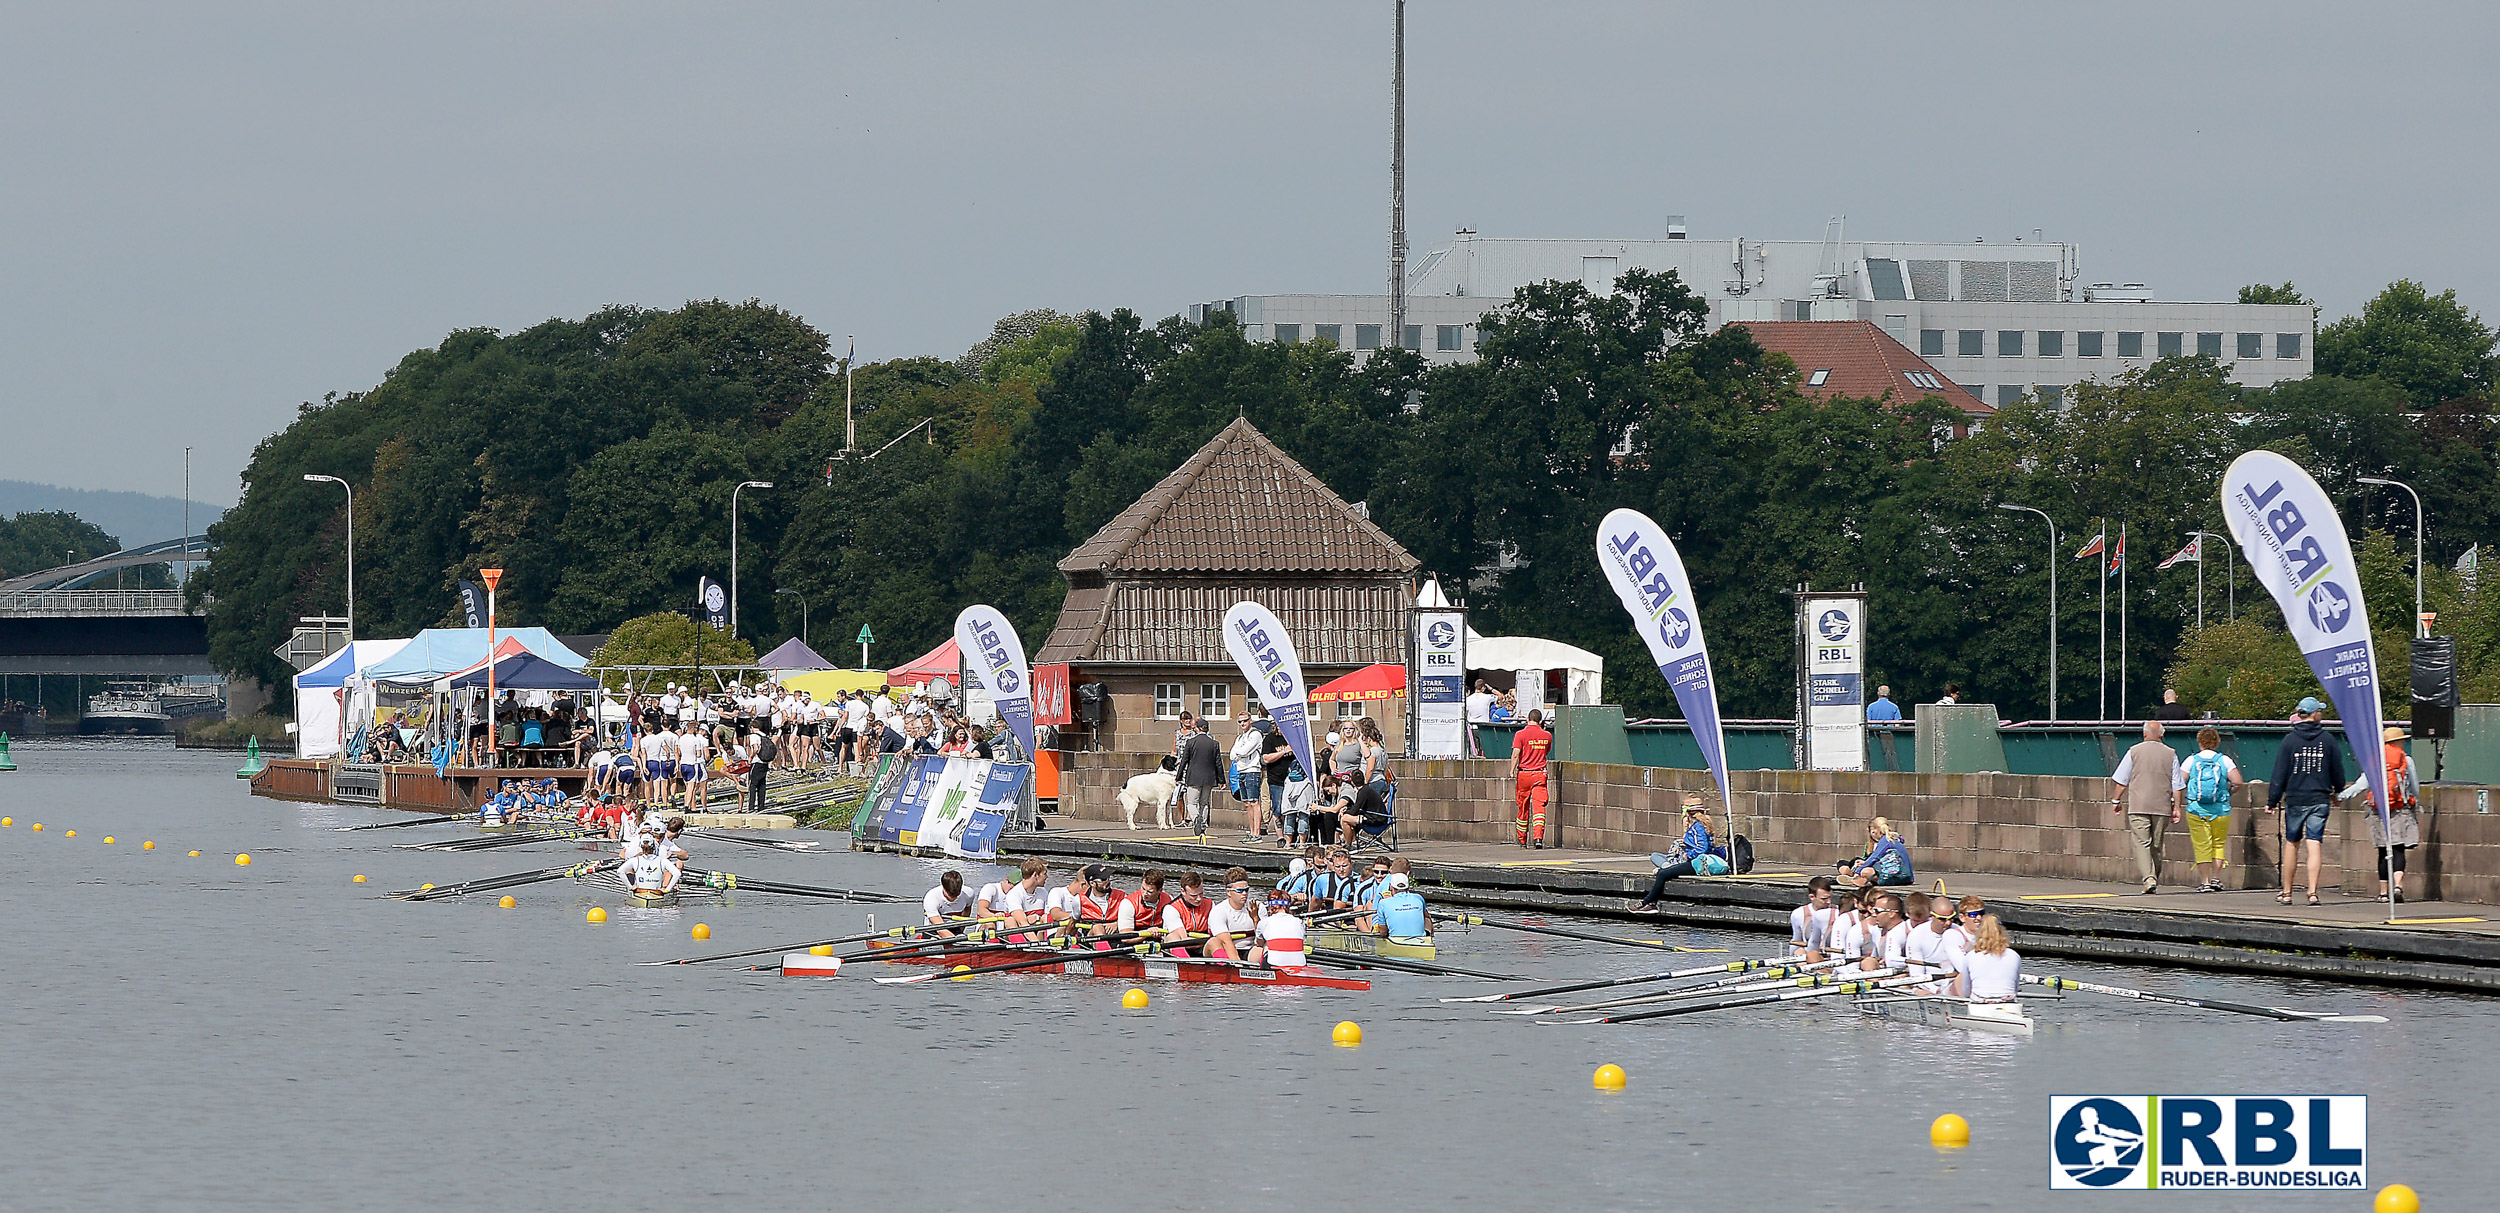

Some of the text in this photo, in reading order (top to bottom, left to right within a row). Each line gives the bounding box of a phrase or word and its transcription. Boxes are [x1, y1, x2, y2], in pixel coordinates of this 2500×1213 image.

[1427, 654, 1456, 665] RBL
[1819, 649, 1851, 660] RBL
[1310, 692, 1337, 702] DLRG
[1343, 690, 1389, 700] DLRG
[1814, 694, 1831, 702] GUT.
